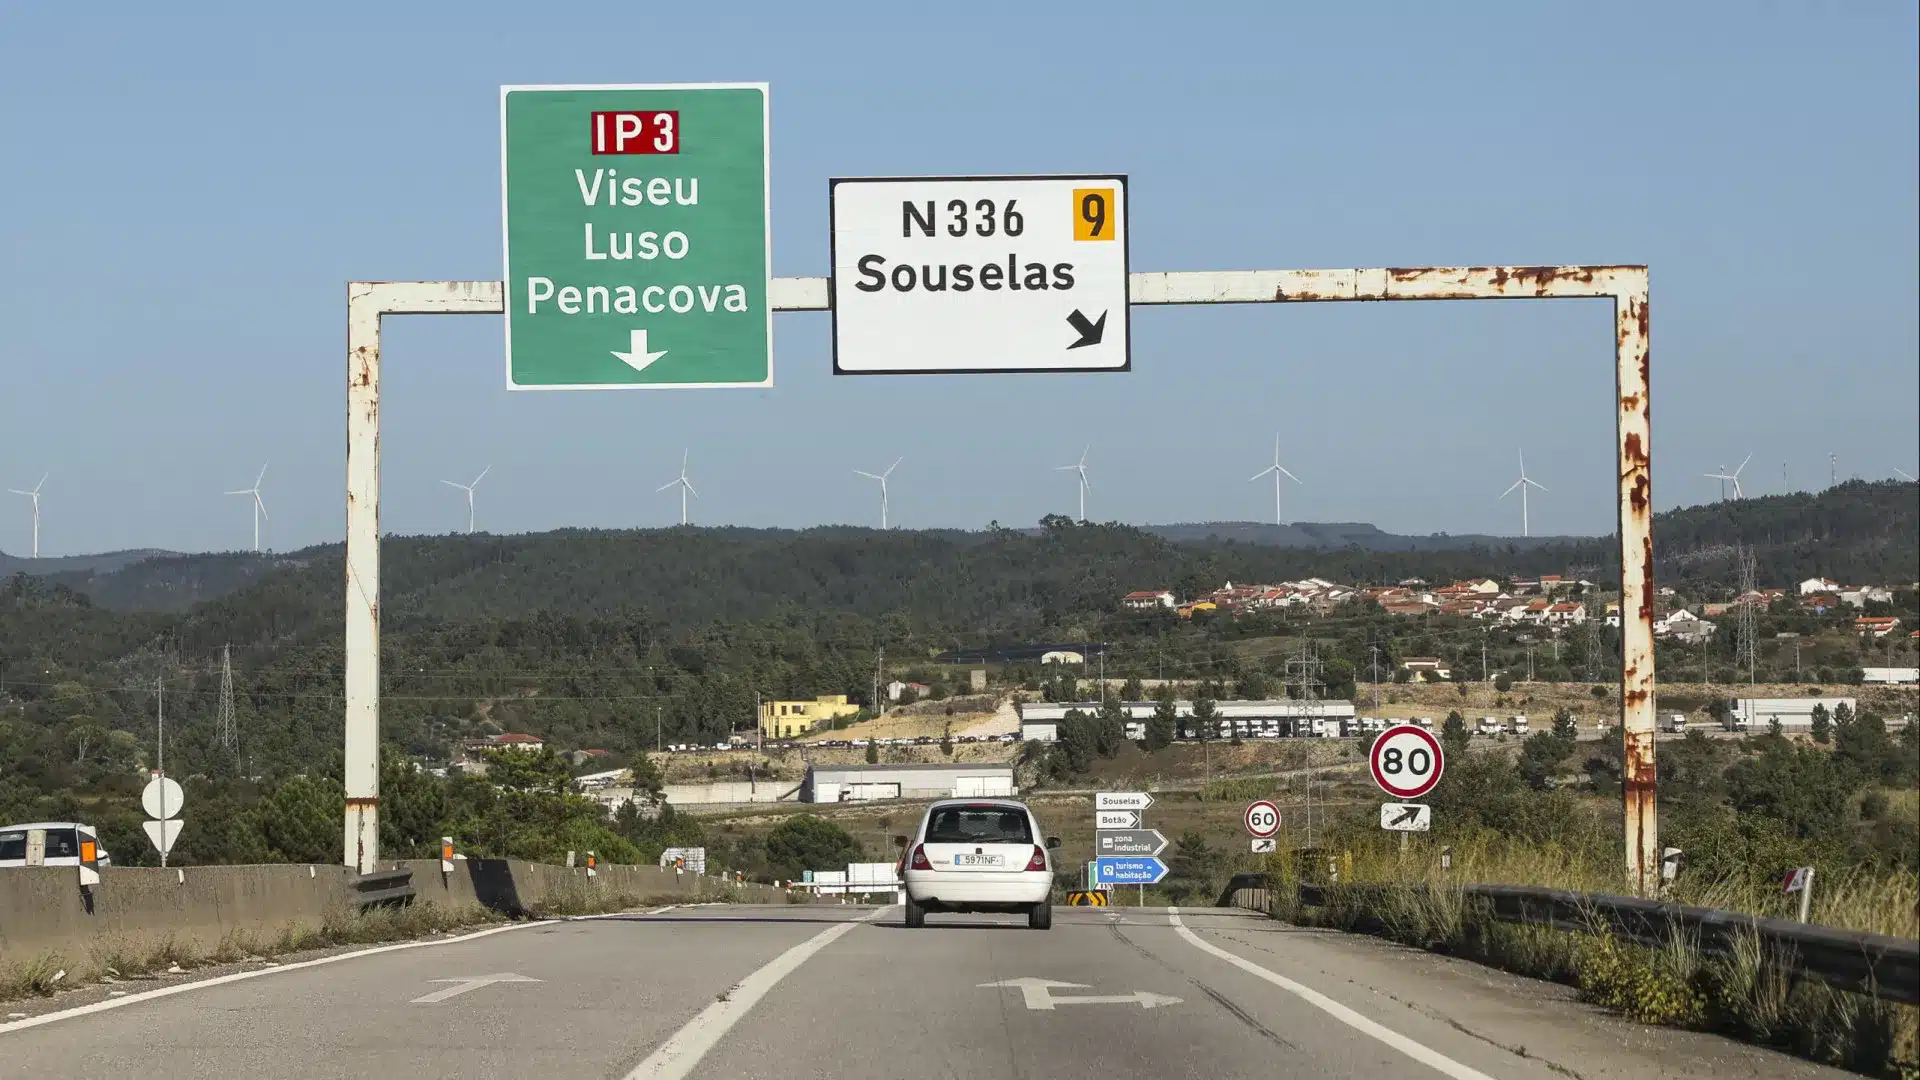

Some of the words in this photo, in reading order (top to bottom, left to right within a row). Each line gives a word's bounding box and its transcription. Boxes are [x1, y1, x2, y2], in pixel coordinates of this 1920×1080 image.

[575, 168, 699, 206] Viseu
[1082, 194, 1105, 237] 9
[585, 223, 689, 260] Luso
[855, 253, 1075, 292] Souselas
[528, 276, 748, 315] Penacova
[1383, 748, 1429, 775] 80
[1102, 797, 1140, 805] Souselas
[1102, 816, 1127, 824] Botão
[1251, 812, 1275, 826] 60
[1116, 861, 1144, 870] turismo
[1116, 871, 1152, 881] habitação
